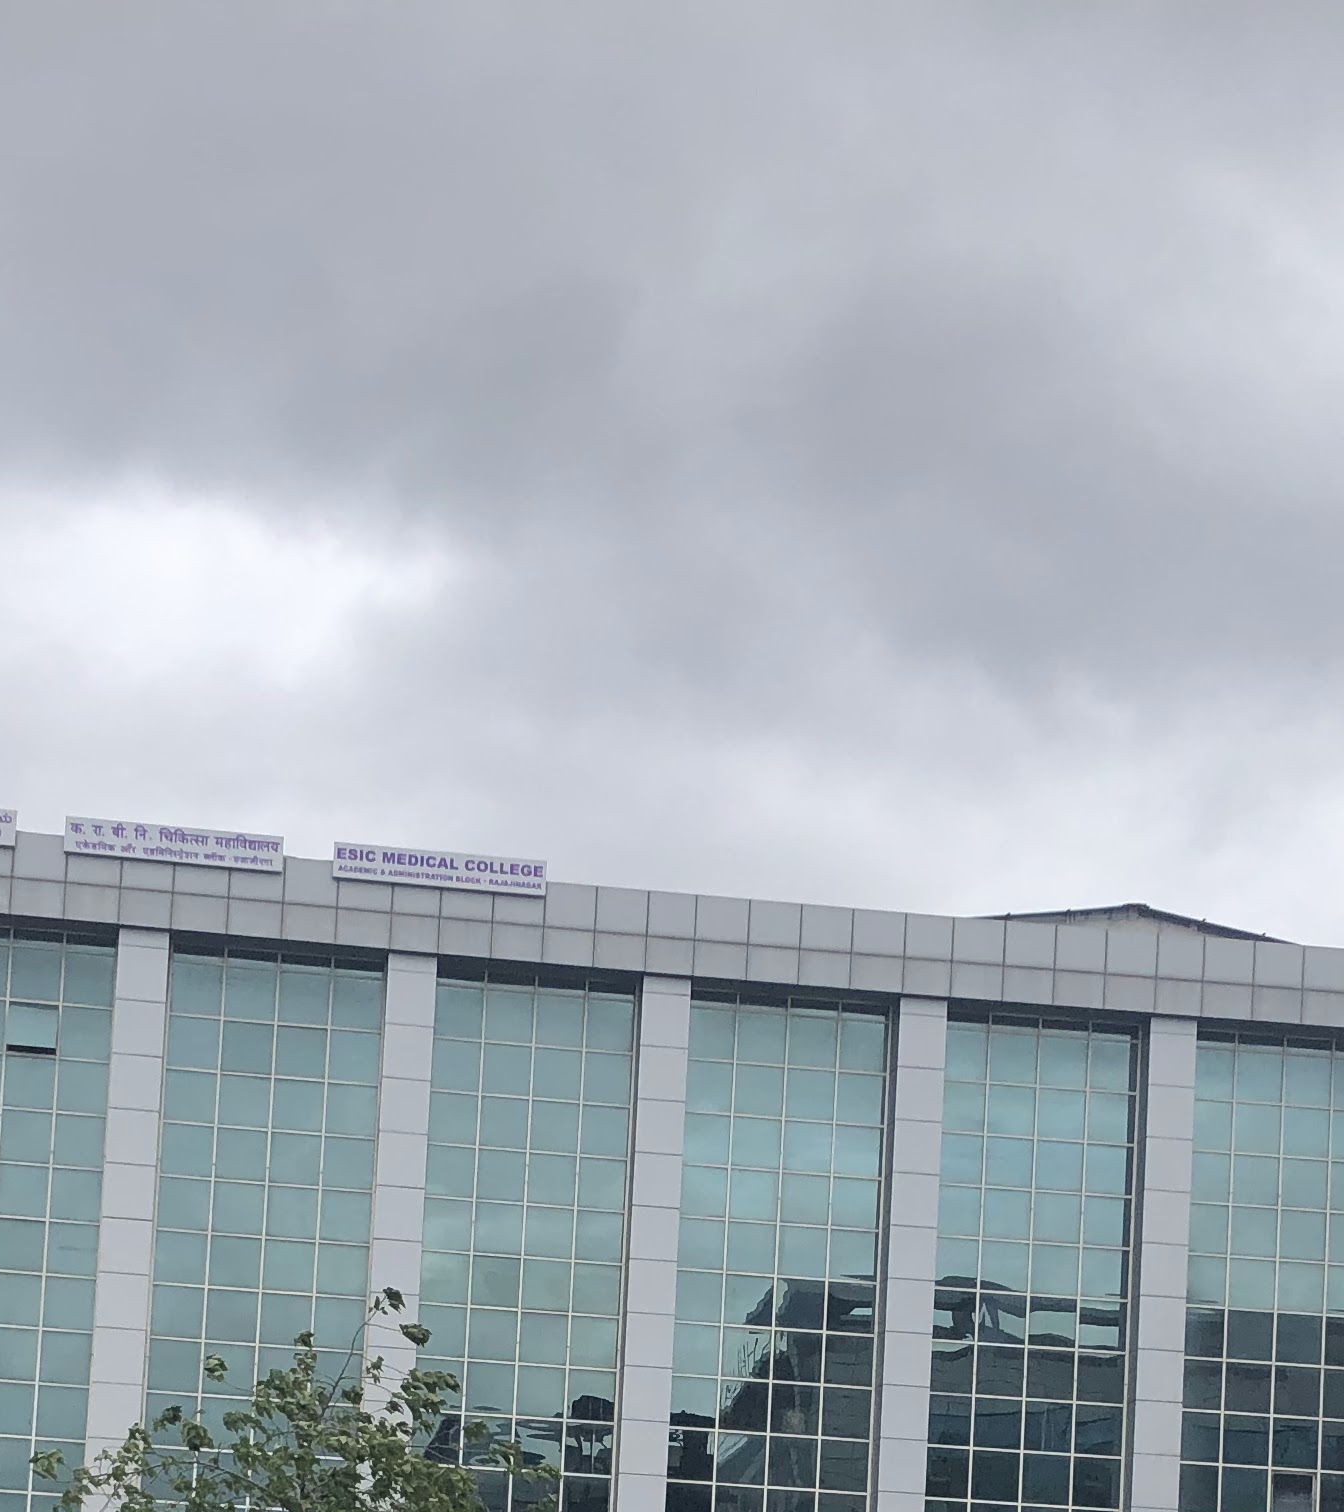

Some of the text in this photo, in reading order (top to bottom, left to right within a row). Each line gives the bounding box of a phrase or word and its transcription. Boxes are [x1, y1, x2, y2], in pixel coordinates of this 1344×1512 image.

[159, 827, 210, 847] चिकित्सा
[213, 833, 280, 853] महाविद्यालय
[336, 846, 544, 879] ESIC MEDICAL COLLEGE
[337, 864, 378, 876] ACADEMIC
[387, 868, 454, 882] ADMINISTRATION
[455, 875, 482, 885] BLOCK
